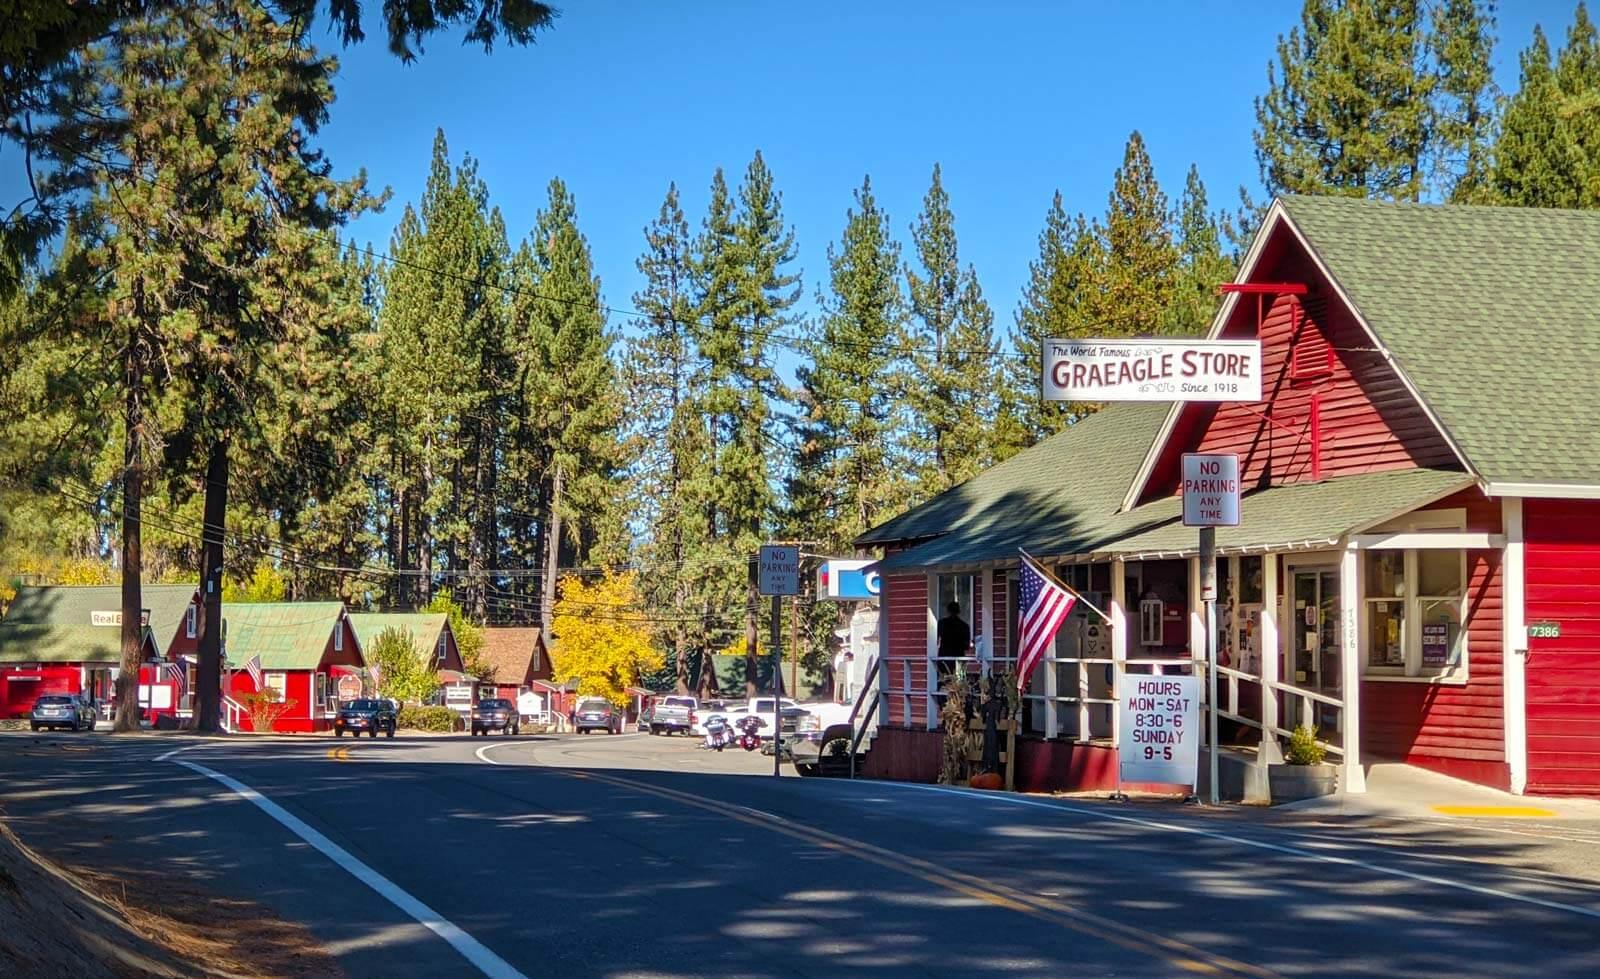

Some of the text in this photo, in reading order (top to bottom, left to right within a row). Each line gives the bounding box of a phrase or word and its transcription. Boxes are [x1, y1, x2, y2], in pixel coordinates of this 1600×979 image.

[1052, 346, 1130, 358] The World Famous
[1052, 350, 1250, 389] GRAEAGLE STORE
[1180, 383, 1238, 393] Since 1918
[1200, 462, 1220, 475] NO
[1186, 480, 1235, 493] PARKING
[1200, 497, 1221, 505] ANY
[1200, 510, 1222, 519] TIME
[772, 552, 785, 560] NO
[762, 563, 796, 573] PARKING
[94, 615, 114, 624] Real
[1532, 627, 1558, 637] 7386
[1138, 682, 1181, 695] HOURS
[1133, 729, 1183, 744] SUNDAY
